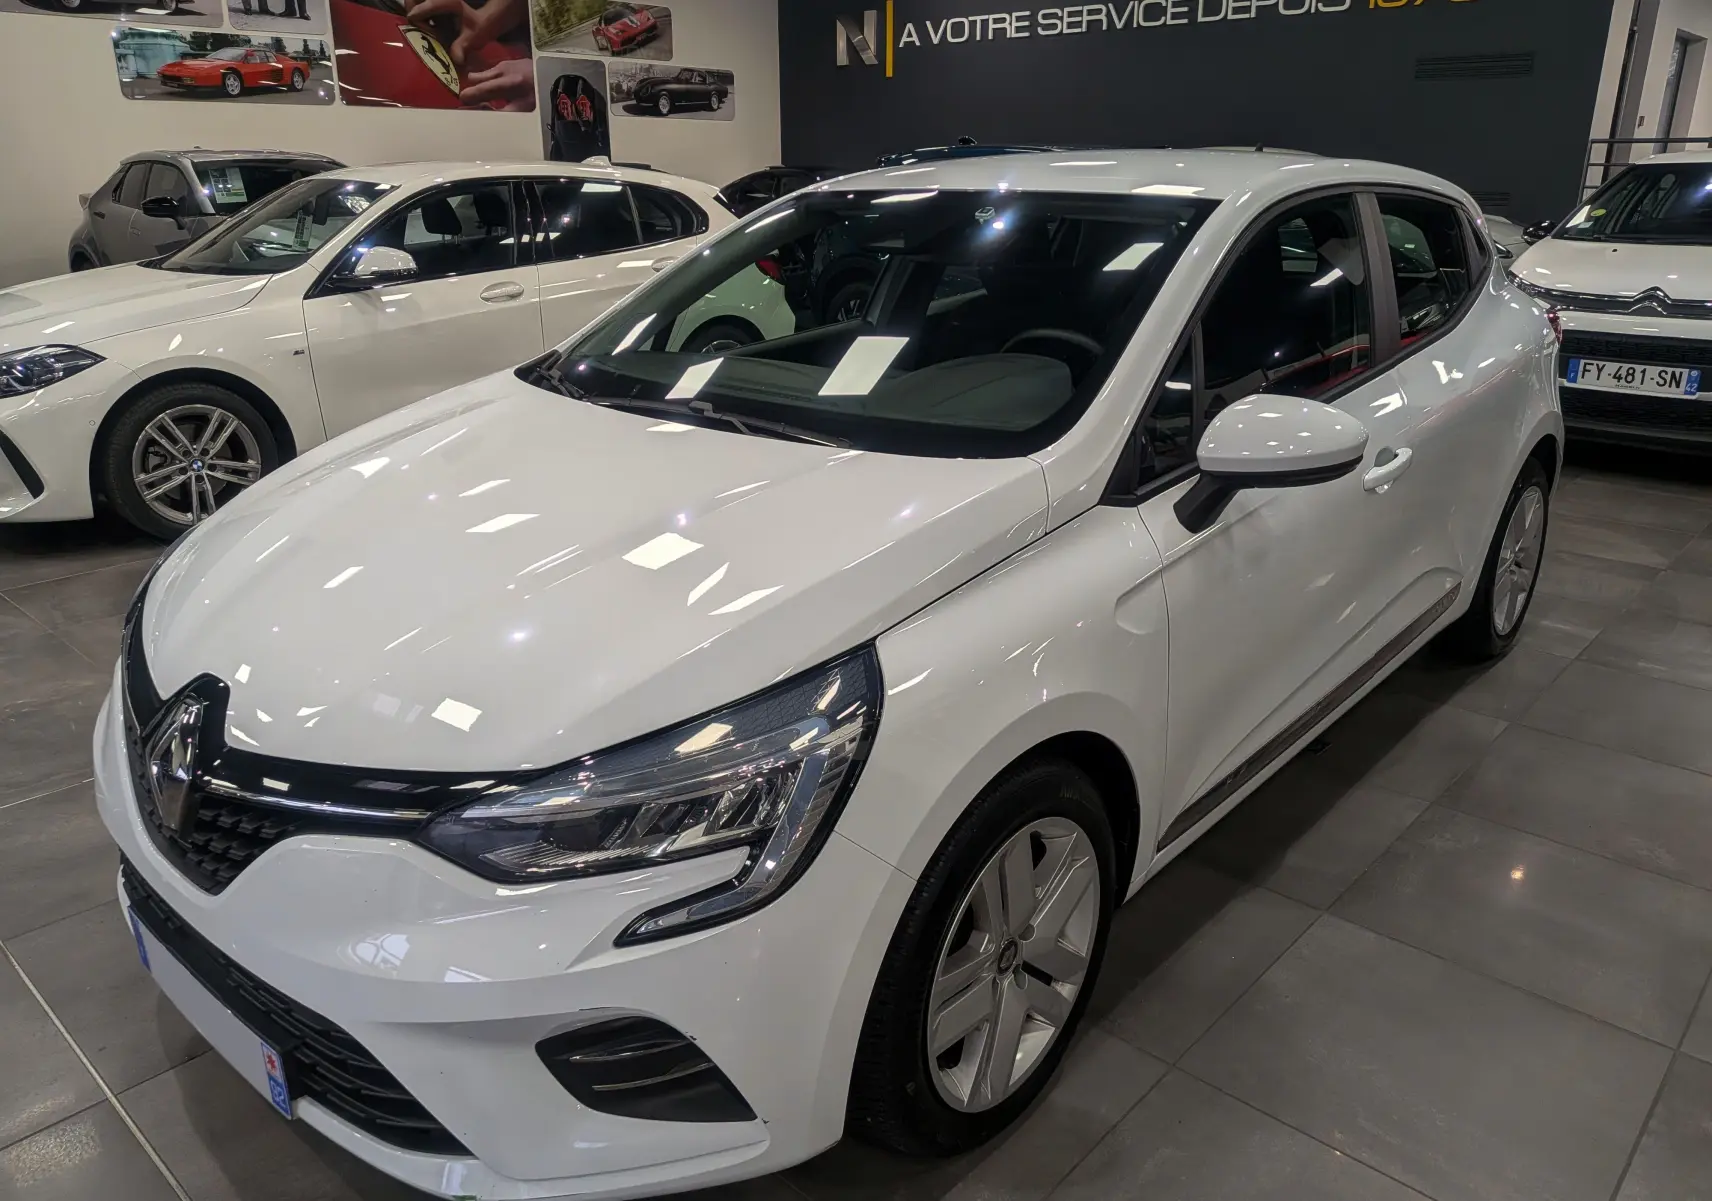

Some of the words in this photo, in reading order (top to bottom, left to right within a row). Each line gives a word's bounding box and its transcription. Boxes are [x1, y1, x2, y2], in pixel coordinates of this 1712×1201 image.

[836, 10, 878, 66] N
[899, 22, 921, 48] A
[925, 10, 1031, 45] VOTRE
[1036, 0, 1189, 36] SERVICE
[1580, 361, 1684, 389] FY-481-SN
[1685, 383, 1698, 393] 42
